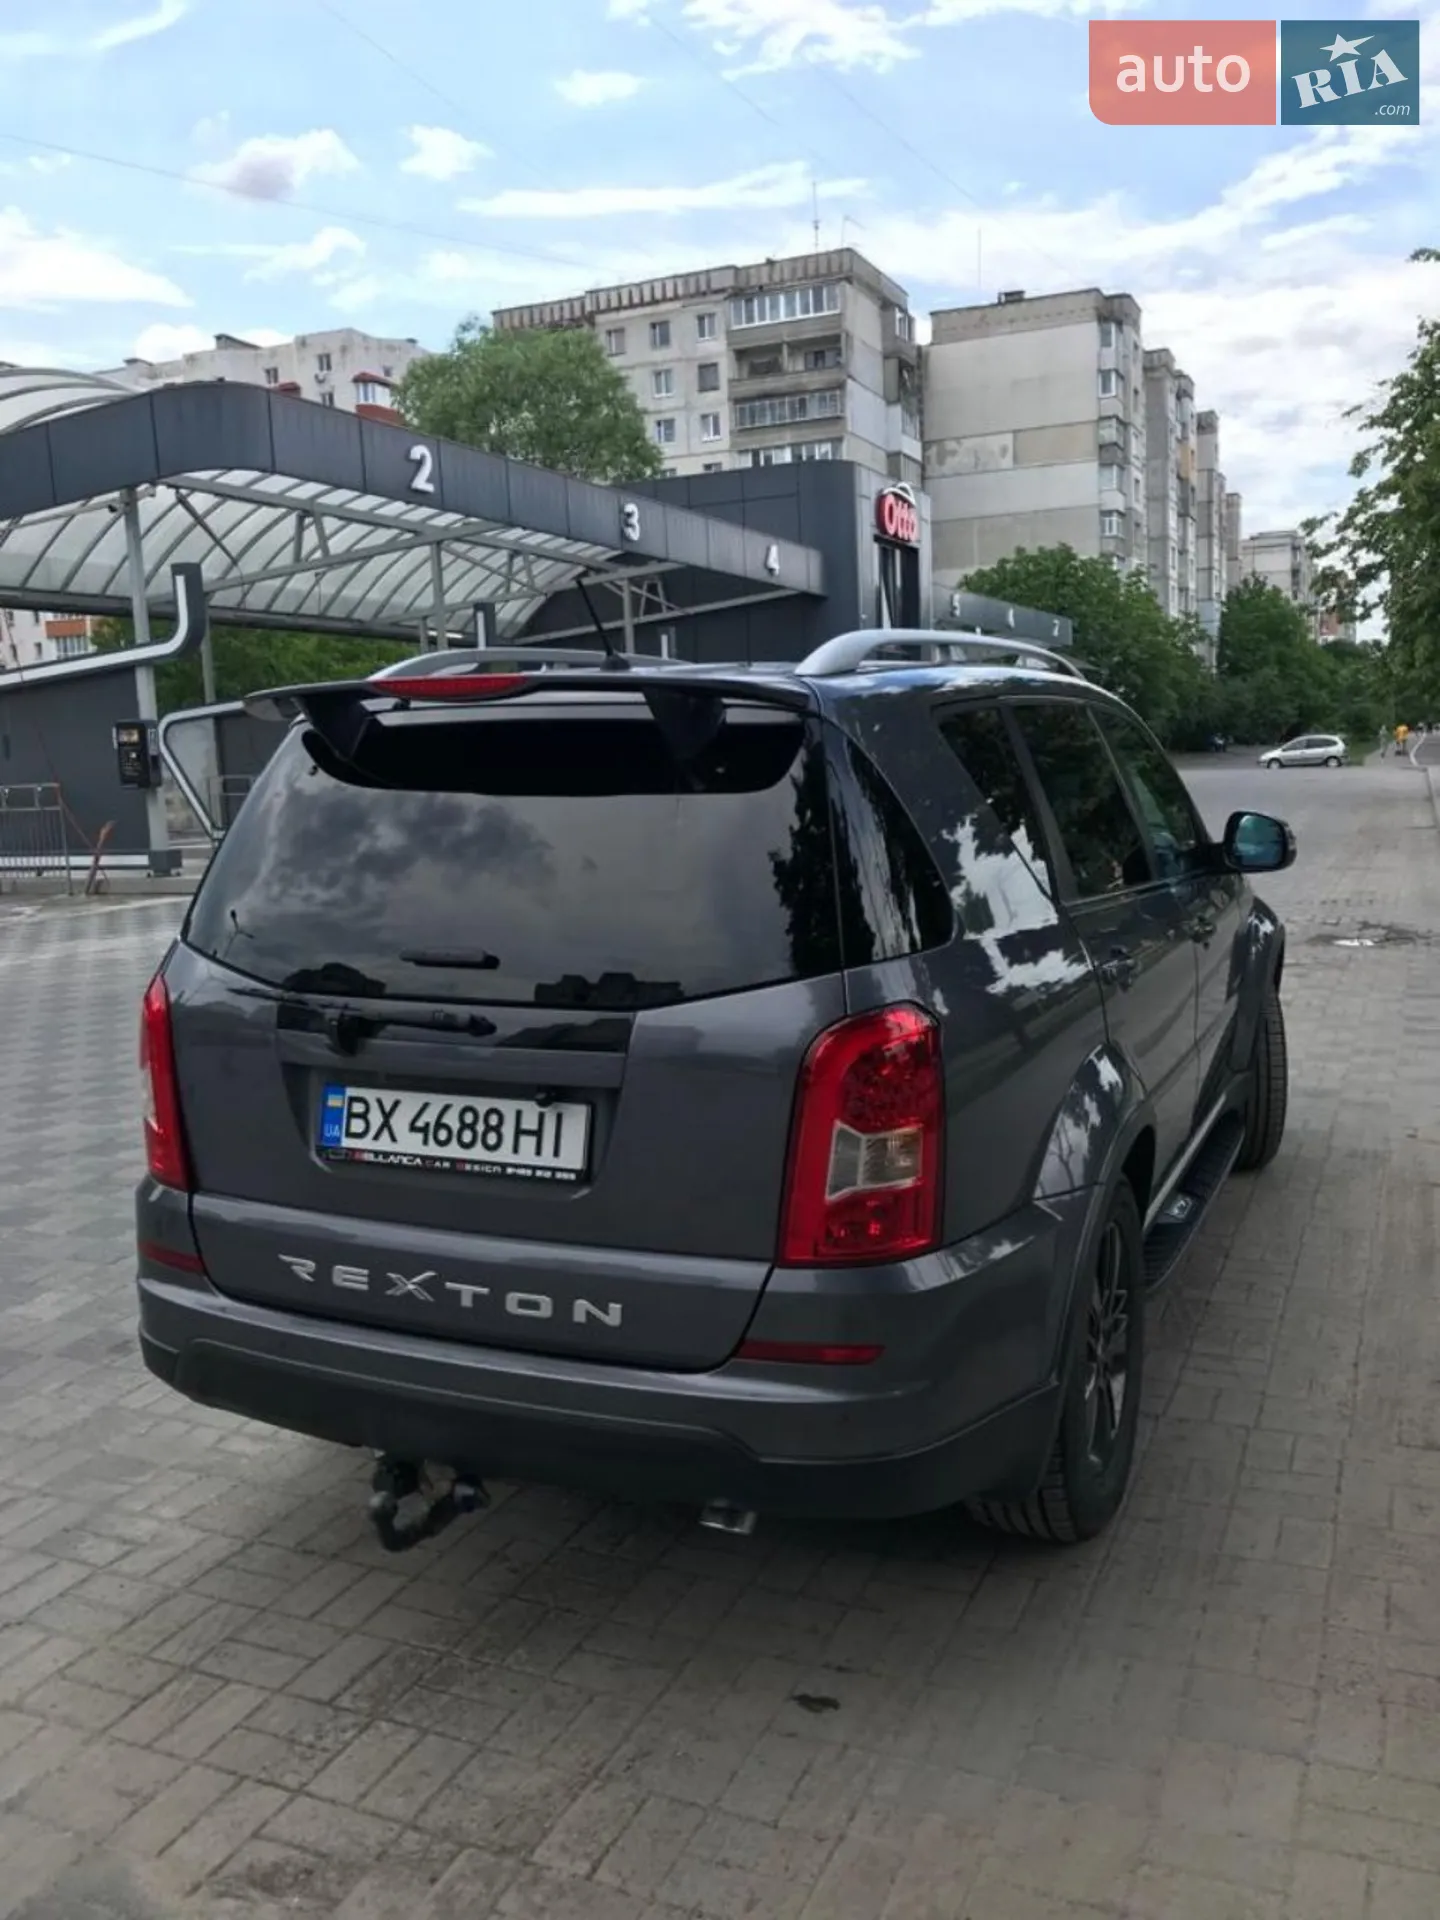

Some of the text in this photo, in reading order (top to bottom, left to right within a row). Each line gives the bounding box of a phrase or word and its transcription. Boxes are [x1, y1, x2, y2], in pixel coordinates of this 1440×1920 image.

[409, 445, 435, 493] 2
[623, 503, 640, 541] 3
[884, 493, 918, 541] Otto
[765, 543, 780, 577] 4
[345, 1095, 563, 1158] BX 4688 HI
[278, 1253, 623, 1327] REXTON
